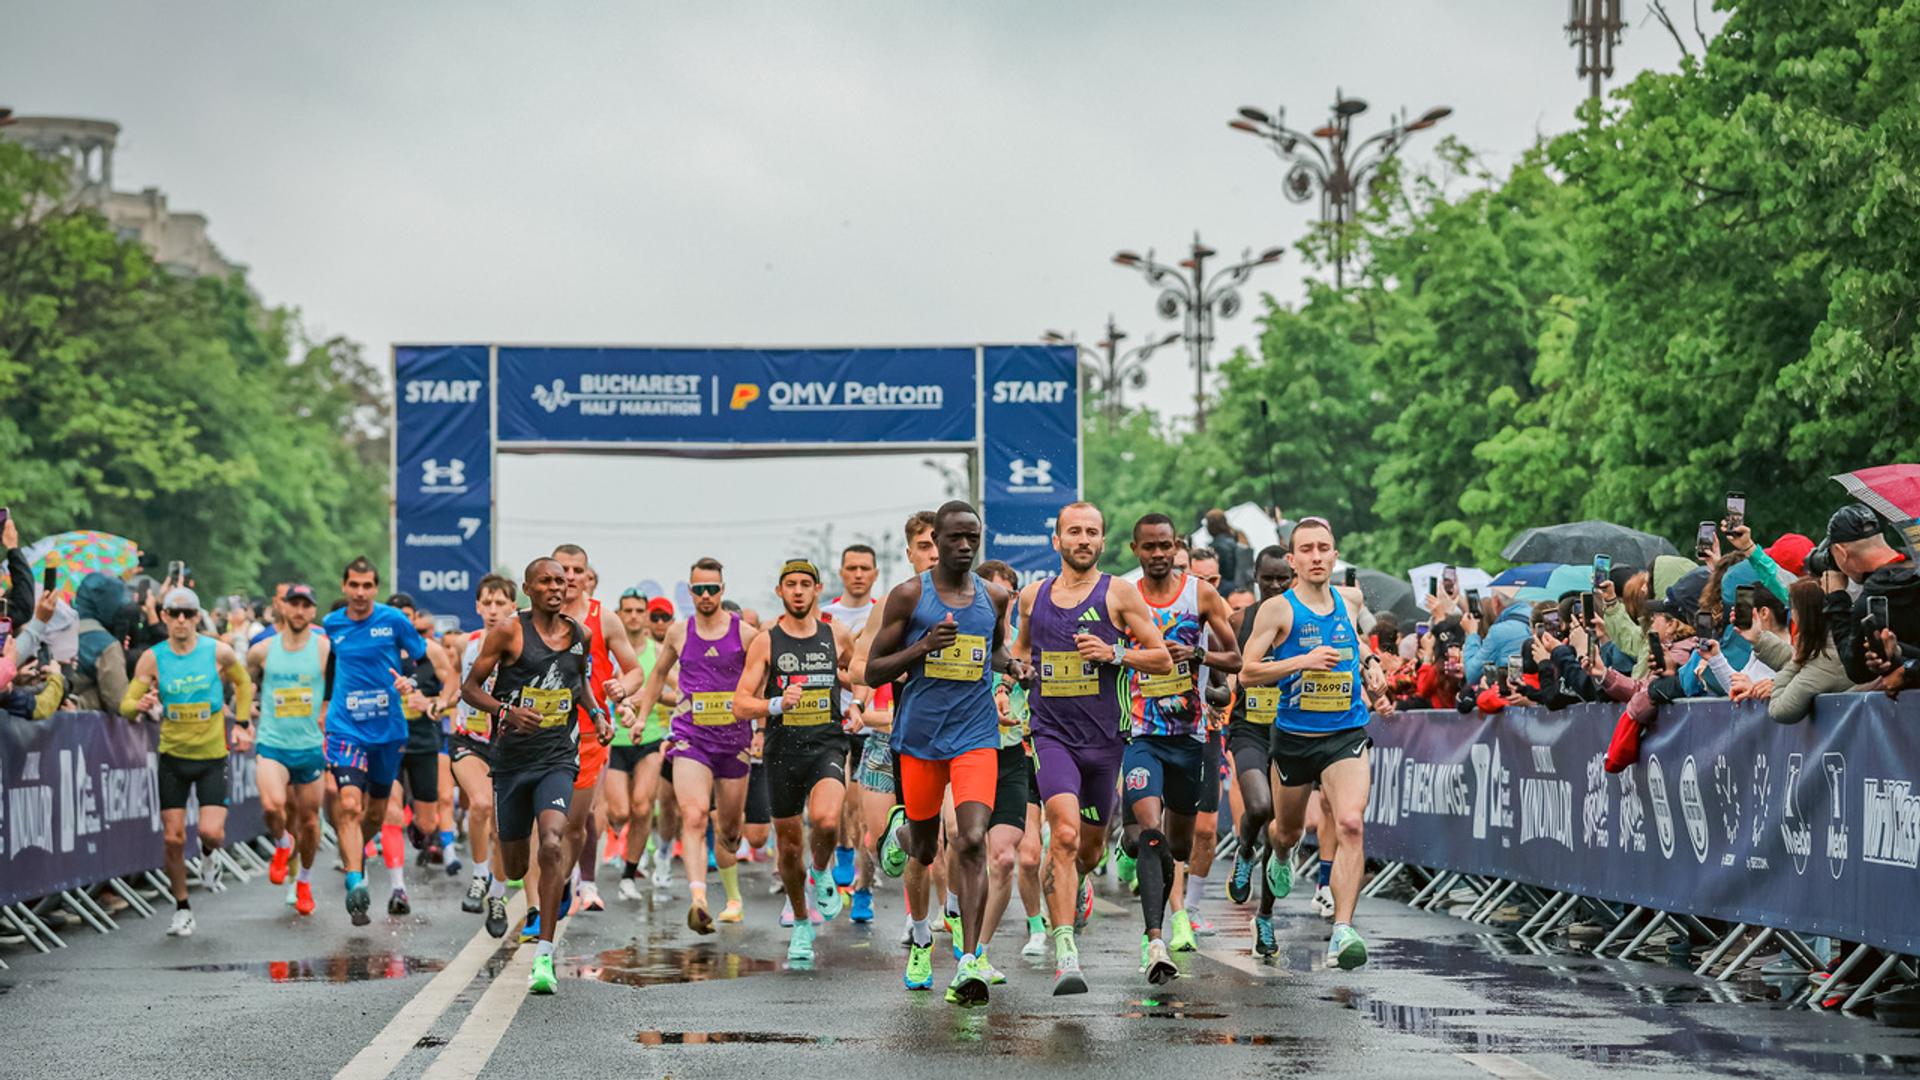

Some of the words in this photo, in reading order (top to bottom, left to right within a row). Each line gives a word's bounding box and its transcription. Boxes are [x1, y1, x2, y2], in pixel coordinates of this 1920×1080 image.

[580, 374, 701, 394] BUCHAREST
[405, 380, 481, 403] START
[768, 381, 836, 405] OMV
[843, 381, 944, 405] Petrom
[993, 380, 1068, 403] START
[580, 400, 616, 416] HALF
[619, 400, 701, 416] MARATHON
[405, 533, 462, 546] Autonom
[993, 533, 1049, 546] Autonom
[418, 570, 469, 592] DIGI
[370, 627, 393, 638] DIGI
[953, 648, 961, 658] 3
[1064, 665, 1069, 675] 1
[1315, 683, 1341, 693] 2699
[1266, 698, 1273, 706] 2
